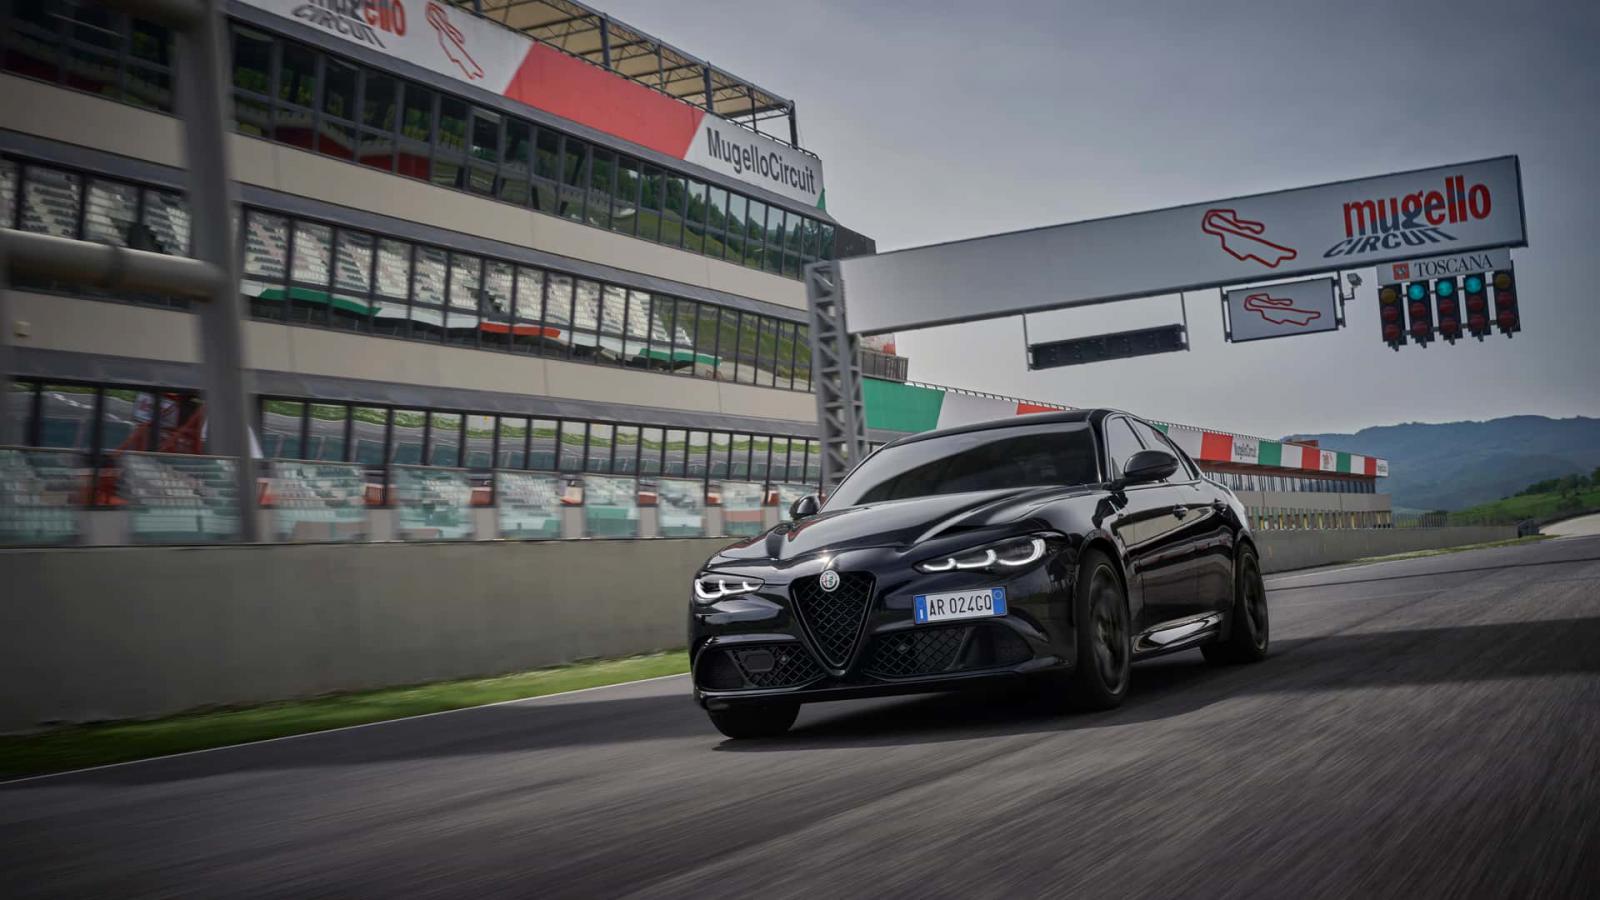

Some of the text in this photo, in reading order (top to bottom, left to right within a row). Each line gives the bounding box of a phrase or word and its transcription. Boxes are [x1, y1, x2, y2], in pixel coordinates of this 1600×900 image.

[291, 4, 387, 49] CIRCUIT
[706, 127, 816, 195] MugelloCircuit
[1343, 175, 1491, 237] mugello
[1323, 227, 1459, 258] CIRCUIT
[1414, 254, 1493, 278] TOSCANA
[929, 599, 945, 616] AR
